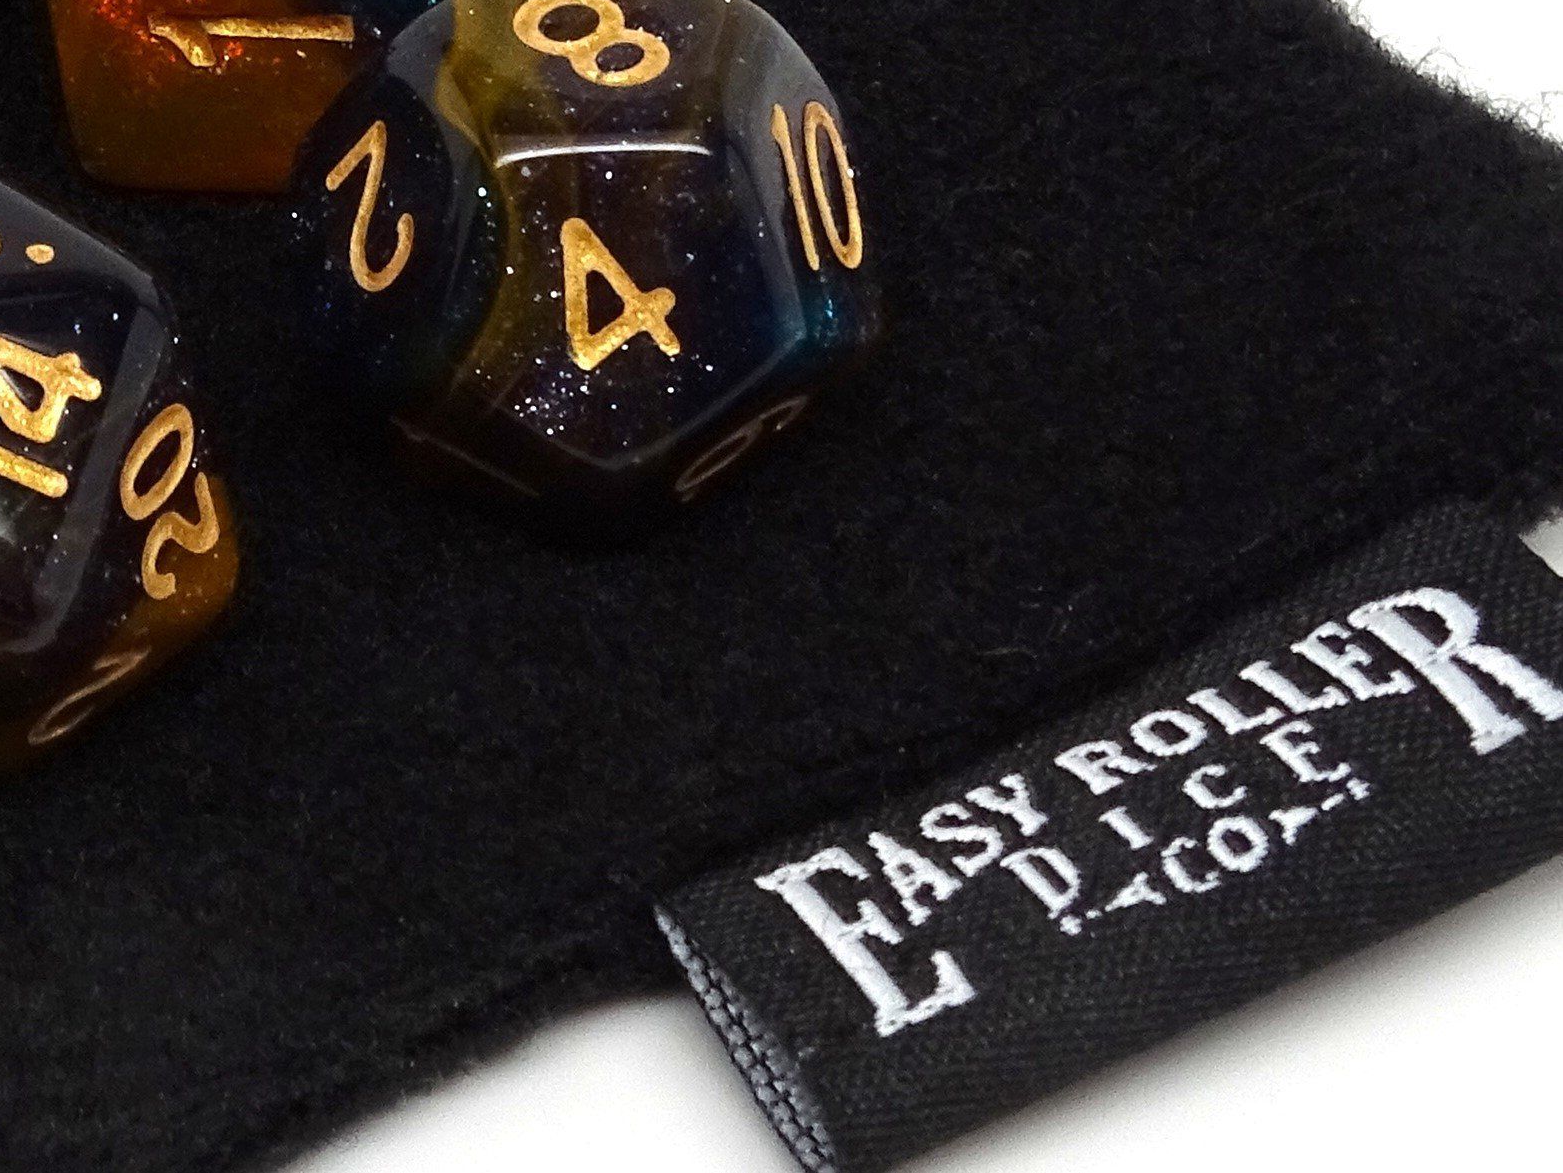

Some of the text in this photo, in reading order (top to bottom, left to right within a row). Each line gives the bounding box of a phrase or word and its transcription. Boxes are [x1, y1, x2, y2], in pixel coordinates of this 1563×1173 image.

[147, 15, 354, 67] 1
[325, 120, 415, 292] 2
[770, 100, 864, 270] 10
[560, 217, 681, 371] 4
[120, 403, 220, 600] 20
[753, 585, 1563, 1038] EASY ROLLER
